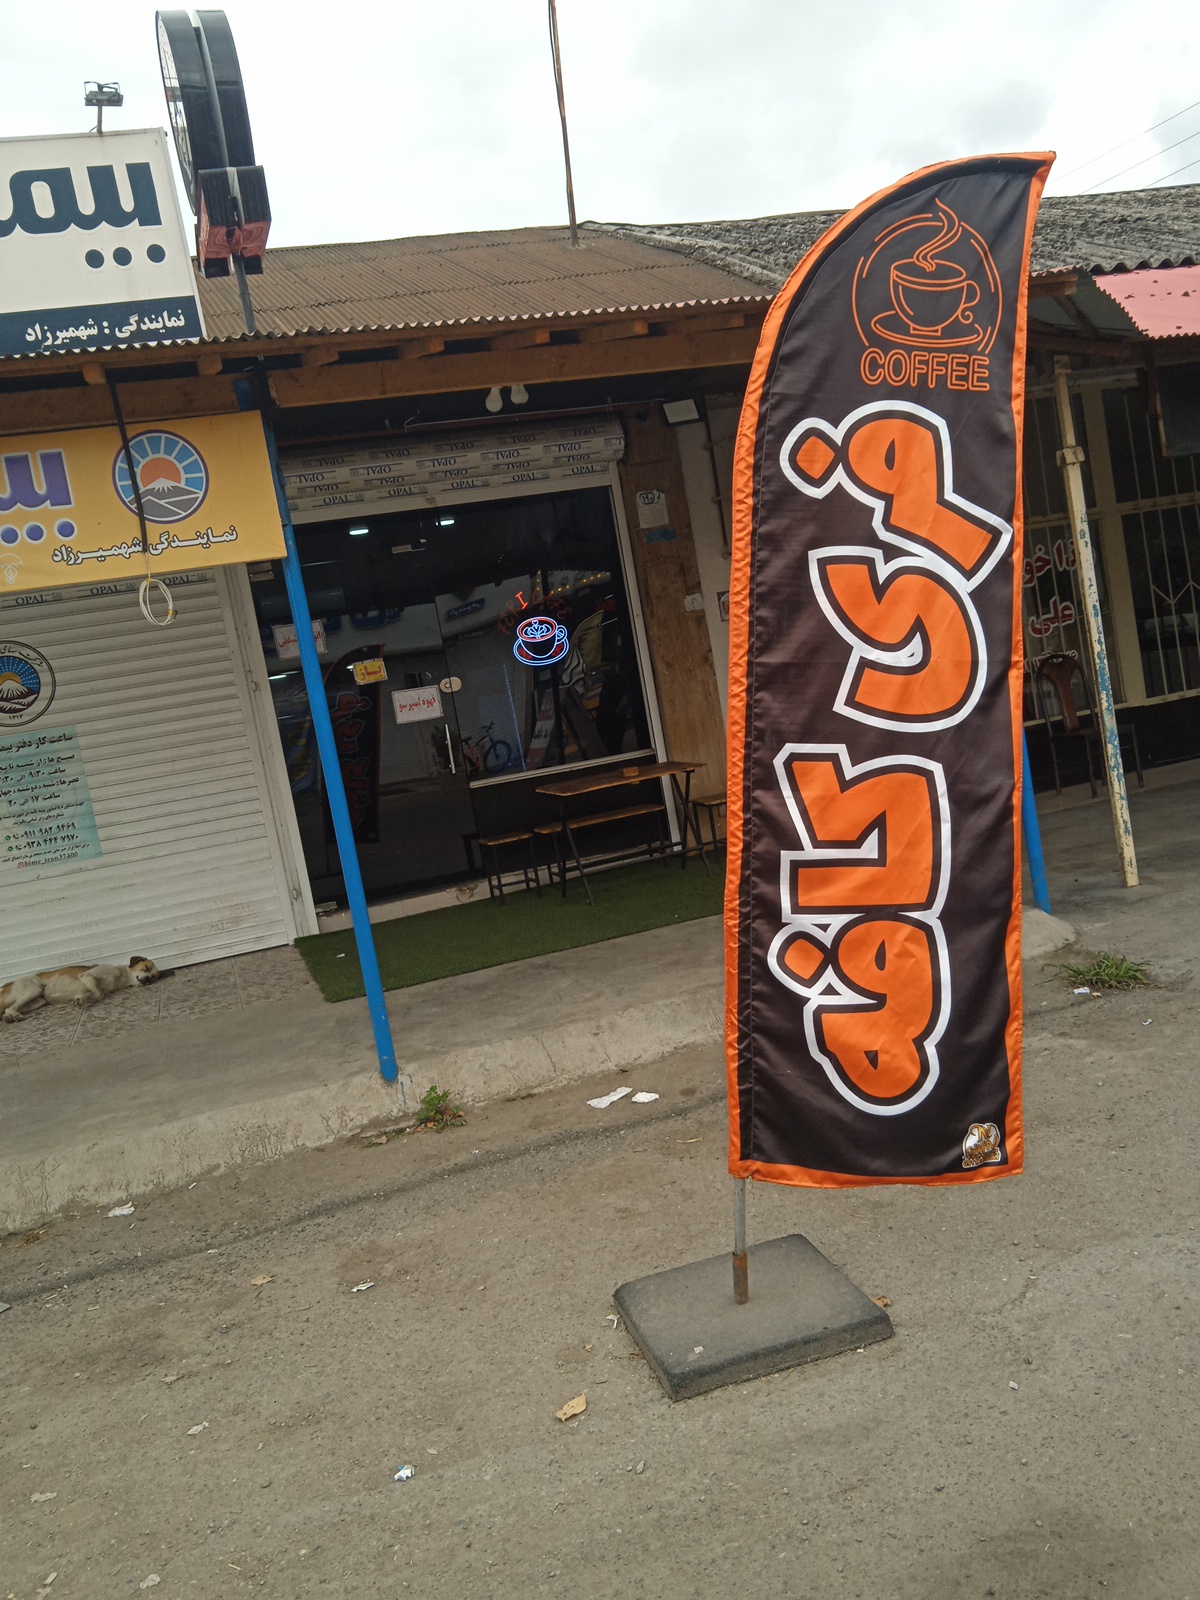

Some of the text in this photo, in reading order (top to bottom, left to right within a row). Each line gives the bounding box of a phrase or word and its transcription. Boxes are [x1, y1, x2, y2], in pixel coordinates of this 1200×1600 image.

[0, 162, 166, 269] بیم
[25, 318, 98, 346] شهمیرزاد
[115, 310, 185, 338] نمایندگی
[860, 349, 990, 392] COFFEE
[297, 443, 581, 484] OPAL OPAL OPAL OPAL OPAL
[323, 464, 597, 505] OPAL OPAL OPAL OPAL OPAL
[52, 525, 238, 566] نمایندگی شهمیرزاد
[15, 574, 193, 606] OPAL OPAL OPAL
[1029, 596, 1076, 638] علی
[359, 664, 383, 682] باز
[15, 739, 33, 753] دفتر
[35, 736, 47, 749] کار
[49, 733, 74, 744] ساعت
[48, 767, 67, 775] ساعت
[767, 400, 1013, 1116] فری کافه
